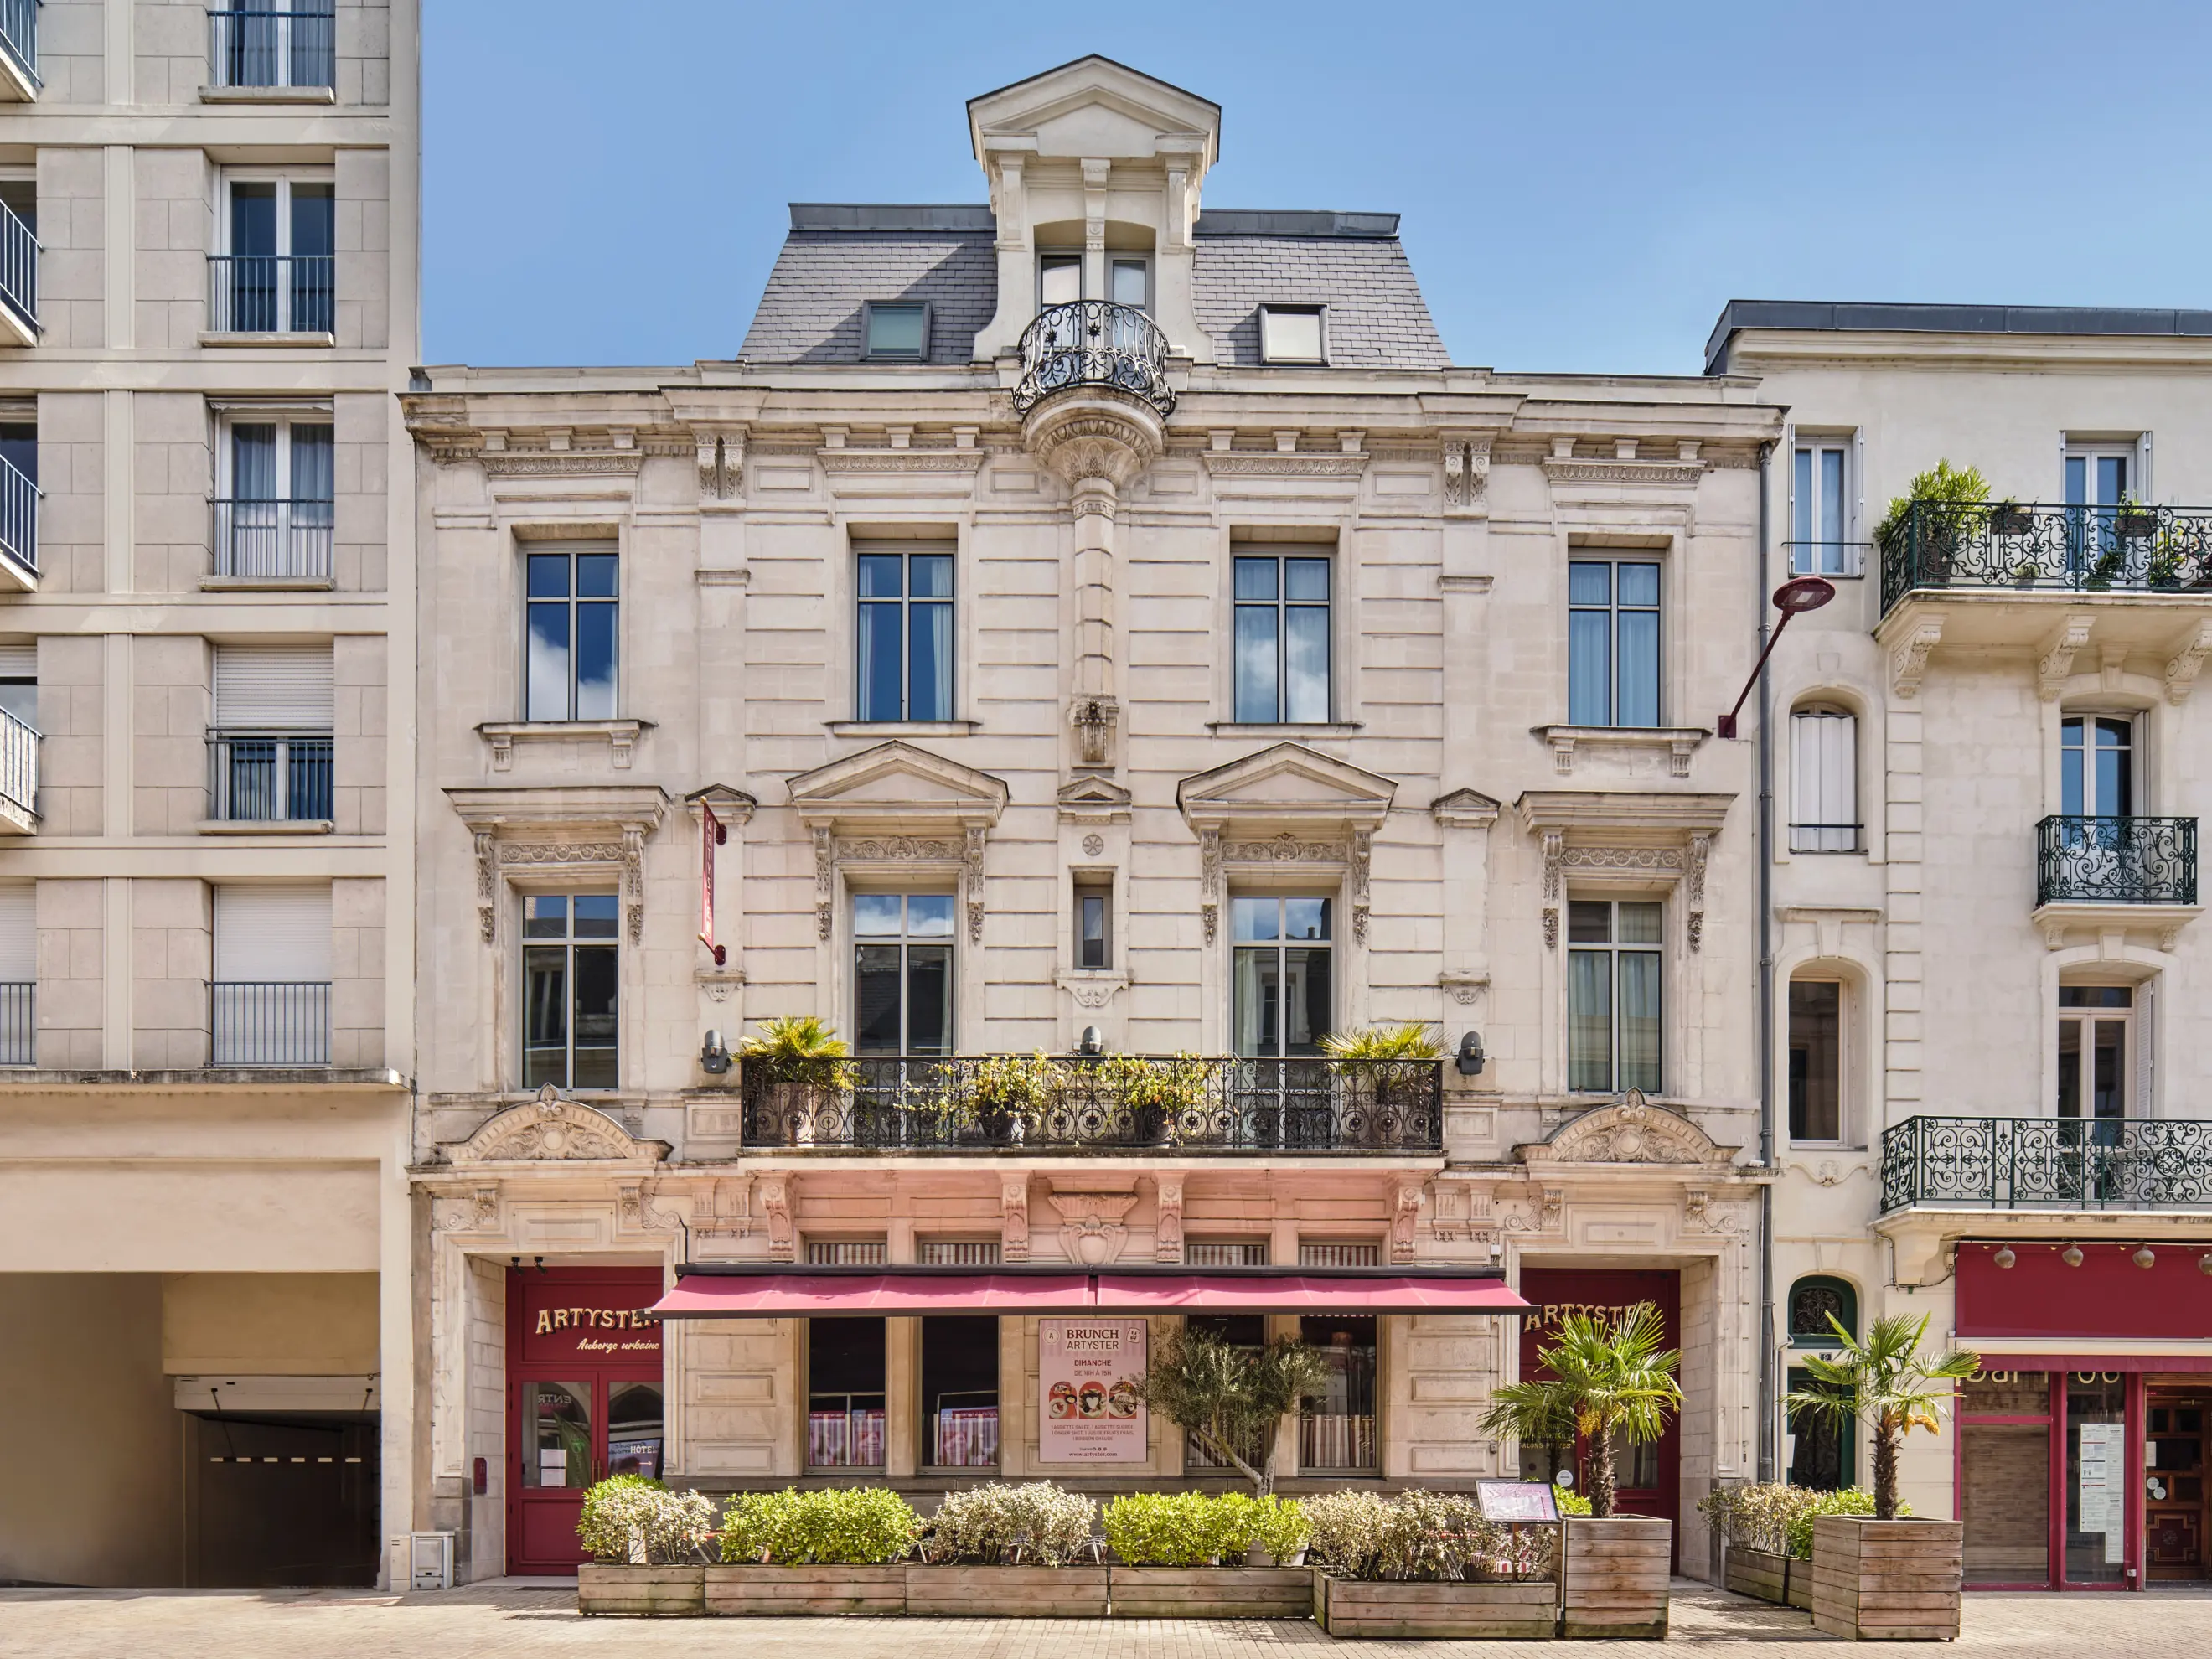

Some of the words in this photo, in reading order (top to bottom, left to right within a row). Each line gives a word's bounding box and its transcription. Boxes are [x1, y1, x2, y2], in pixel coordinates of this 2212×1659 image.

[1066, 1329, 1119, 1339] BRUNCH
[576, 1338, 618, 1354] Auberge
[621, 1339, 660, 1350] urbaine
[1067, 1341, 1119, 1350] ARTYSTER
[1096, 1368, 1100, 1377] À
